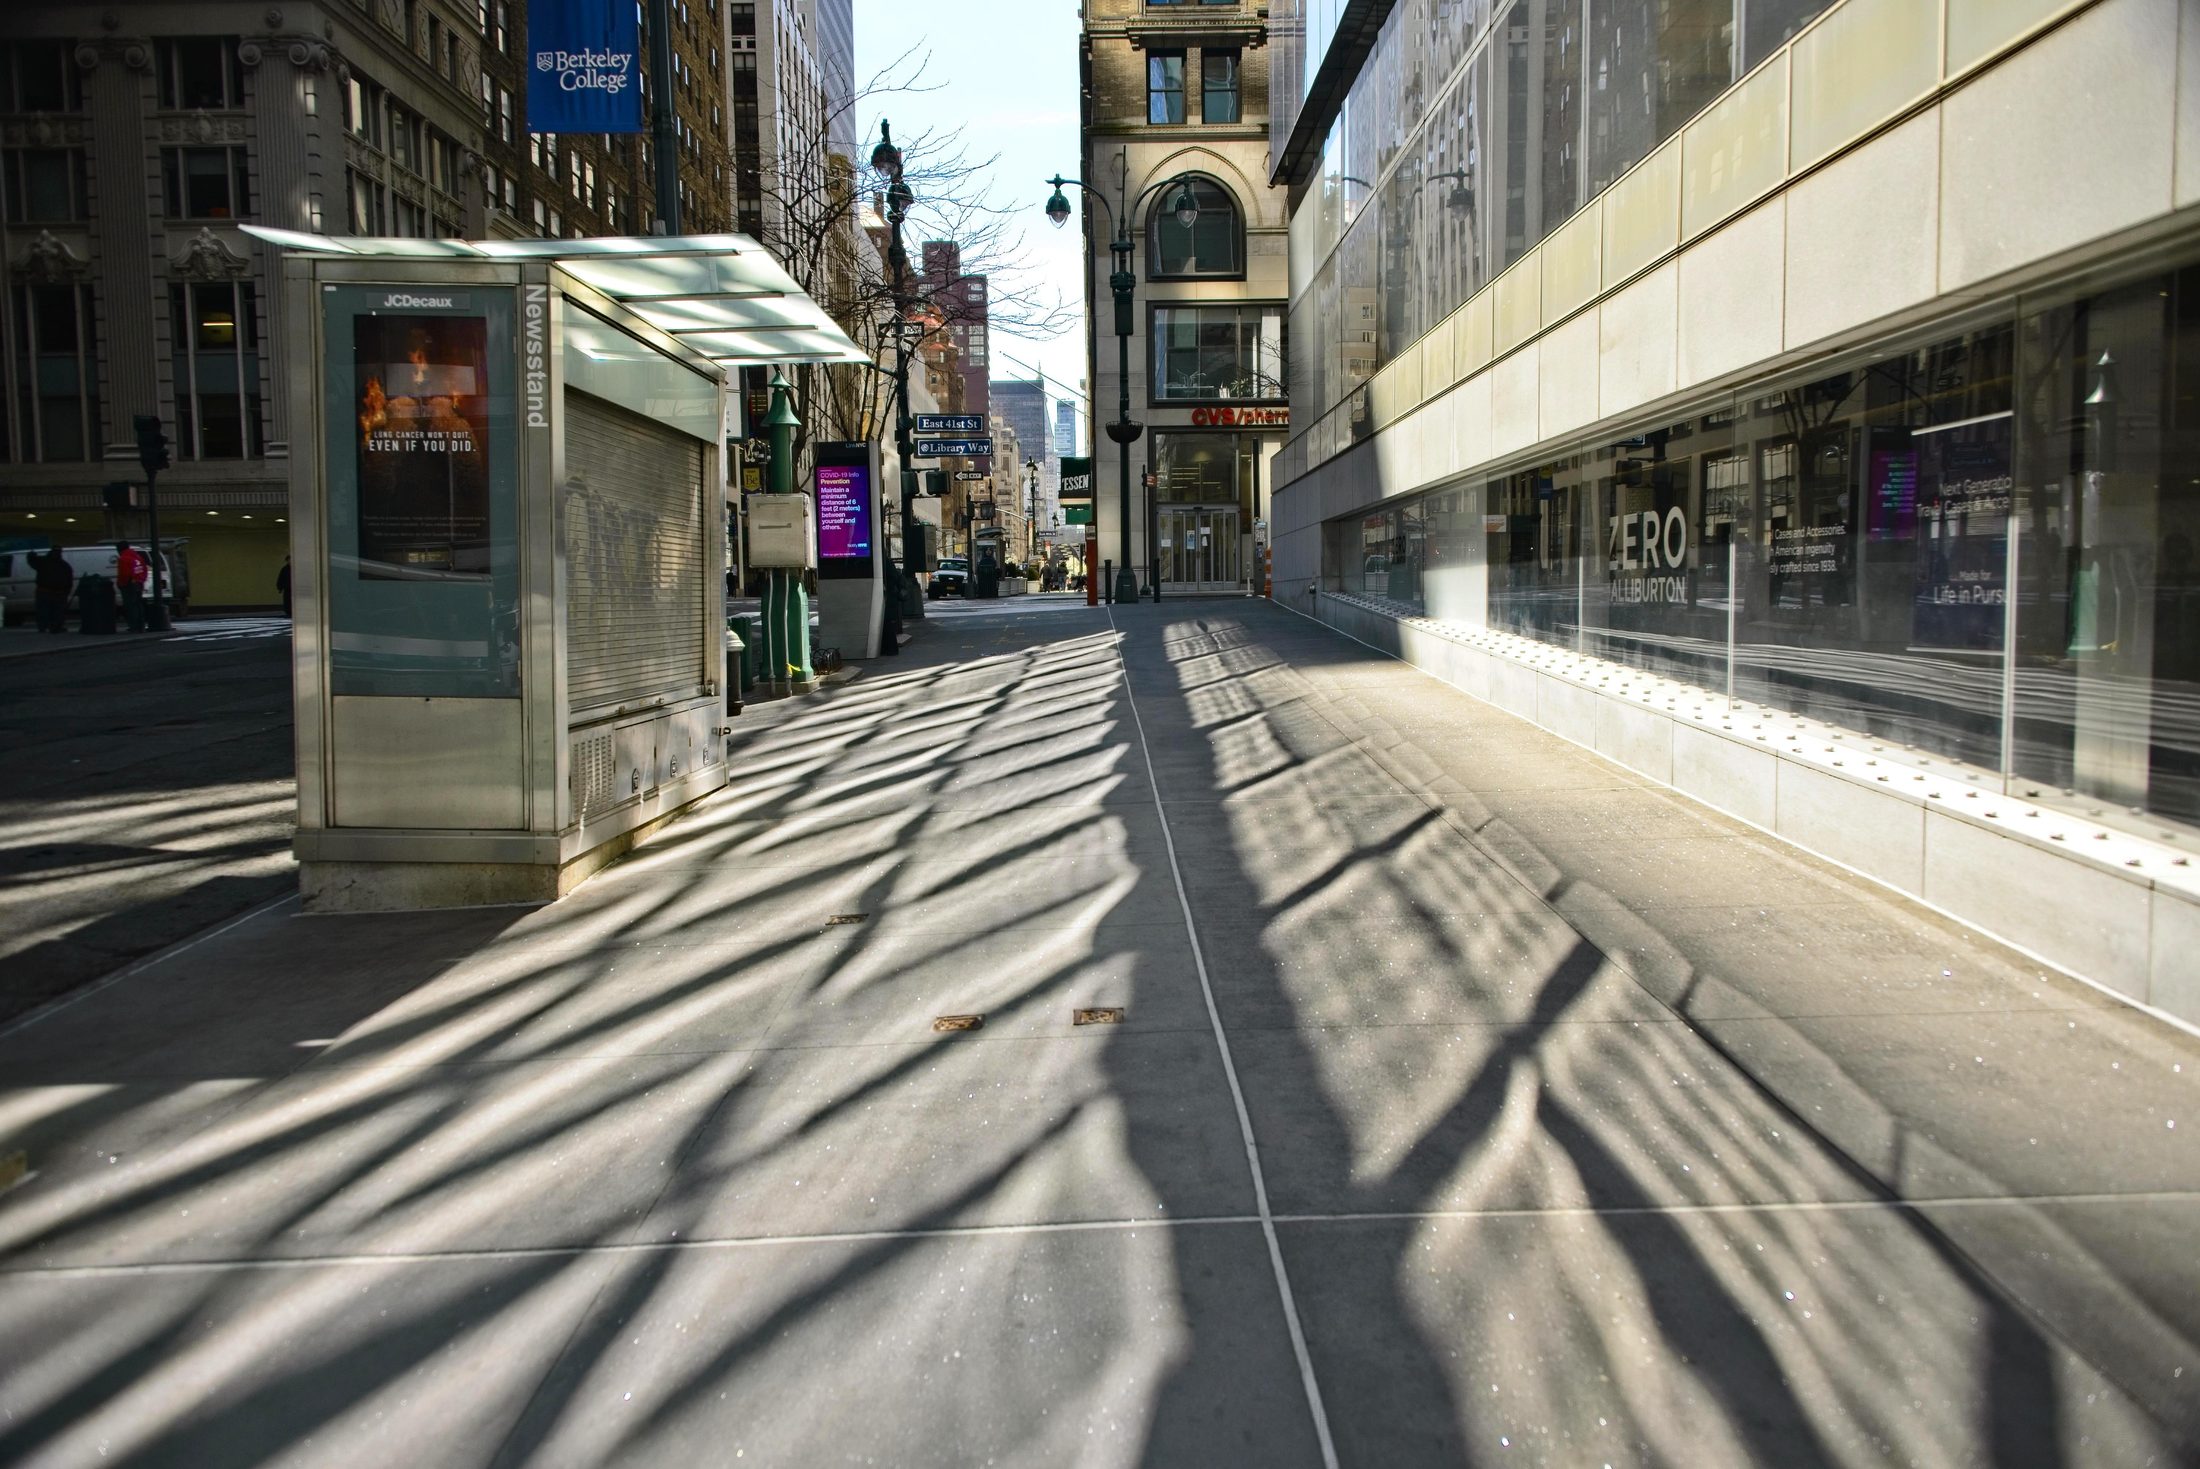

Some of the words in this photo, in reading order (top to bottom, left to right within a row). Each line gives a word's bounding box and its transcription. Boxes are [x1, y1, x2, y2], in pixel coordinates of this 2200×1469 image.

[555, 48, 631, 72] Berkeley
[560, 69, 628, 93] College
[384, 294, 452, 307] JCDecaux
[526, 285, 548, 427] Newsstand
[923, 419, 943, 428] East
[945, 420, 965, 428] 41st
[967, 419, 977, 428] St
[1192, 407, 1289, 425] CVS/pharm
[369, 440, 399, 451] EVEN
[406, 440, 417, 451] IF
[423, 440, 445, 451] YOU
[452, 440, 476, 451] DID.
[930, 443, 965, 453] Library
[968, 443, 989, 453] Way
[1939, 484, 1961, 496] Next
[1963, 475, 2012, 494] Generatio
[1609, 506, 1687, 570] ZERO
[1775, 528, 1793, 539] Cases
[1793, 526, 1805, 538] and
[1775, 545, 1804, 556] American
[1805, 543, 1835, 556] ingenuity
[1780, 561, 1801, 573] crafted
[1803, 561, 1819, 572] since
[1610, 576, 1687, 604] ALLIBURTON
[1934, 585, 1956, 604] Life
[1959, 585, 1970, 603] in
[1973, 585, 2006, 604] Purs
